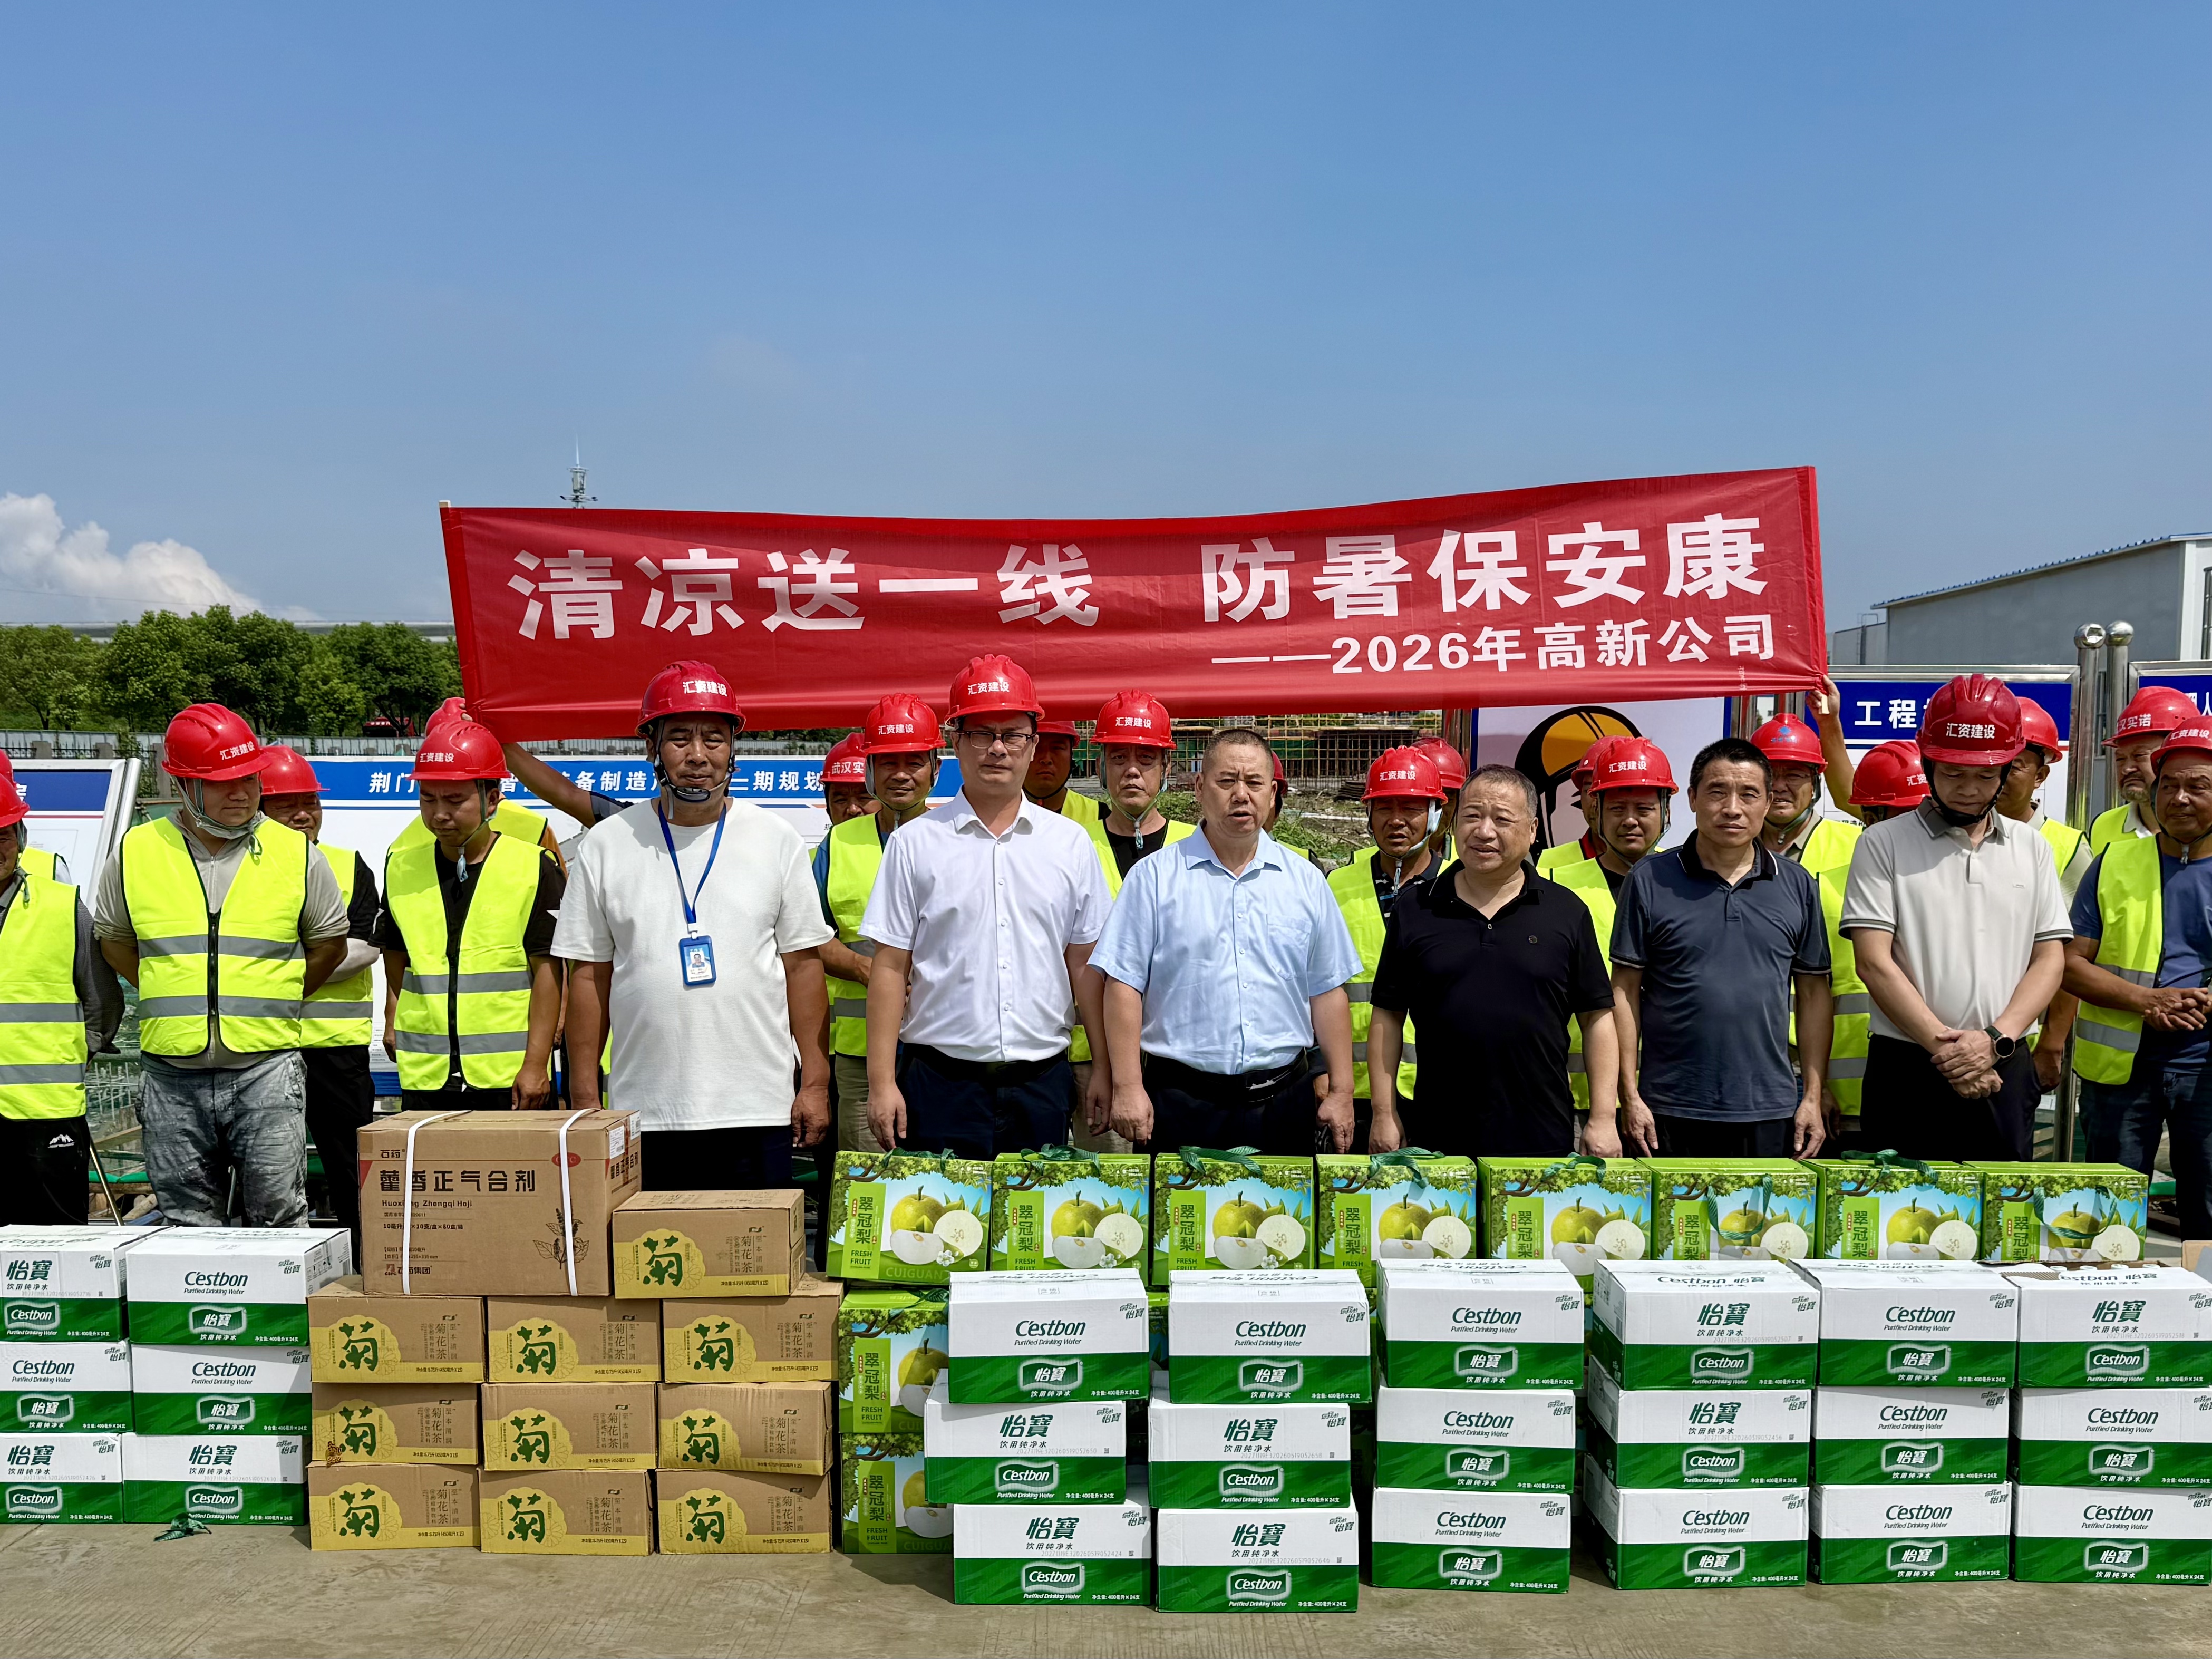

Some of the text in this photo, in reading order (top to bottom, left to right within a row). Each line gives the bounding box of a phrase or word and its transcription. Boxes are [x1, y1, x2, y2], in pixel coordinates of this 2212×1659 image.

[506, 512, 1768, 641] 清凉送一线 防暑保安康
[682, 680, 727, 697] 汇资建设
[967, 681, 1010, 696] 汇资建设
[1115, 716, 1152, 730] 汇资建设
[1854, 698, 1929, 729] 工程
[2117, 713, 2151, 732] 汉实诺
[878, 723, 914, 735] 汇资建设
[1946, 722, 1996, 739] 汇资建设
[2169, 729, 2210, 741] 汇资建设
[219, 741, 256, 761] 汇资建设
[420, 752, 454, 763] 汇资建设
[832, 762, 864, 774] 武汉实
[1379, 769, 1416, 781] 汇资建设
[1608, 759, 1647, 773] 汇资建设
[1906, 774, 1929, 786] 汇资
[382, 1200, 419, 1208] Huoxing
[856, 1197, 874, 1244] 翠冠梨
[1018, 1205, 1033, 1252] 翠冠梨
[1180, 1204, 1195, 1251] 翠冠梨
[1345, 1207, 1360, 1255] 翠冠梨
[1518, 1211, 1534, 1258] 翠冠梨
[1852, 1211, 1868, 1257] 翠冠梨
[642, 1235, 683, 1287] 菊
[741, 1236, 752, 1273] 菊花茶
[6, 1260, 52, 1280] 怡寶
[886, 1267, 943, 1280] CUIGUAN
[203, 1314, 231, 1326] 怡寶
[1697, 1303, 1750, 1325] 怡寶
[2092, 1301, 2146, 1322] 怡寶
[339, 1321, 378, 1371] 菊
[435, 1323, 447, 1360] 菊花茶
[516, 1325, 556, 1376] 菊
[615, 1323, 625, 1360] 菊花茶
[693, 1322, 734, 1371] 菊
[792, 1322, 803, 1358] 菊花茶
[1470, 1355, 1501, 1367] 怡寶
[1903, 1353, 1934, 1366] 怡寶
[865, 1352, 880, 1400] 翠冠梨
[1035, 1367, 1066, 1381] 怡寶
[1255, 1369, 1286, 1382] 怡寶
[32, 1402, 59, 1414] 怡寶
[211, 1404, 239, 1416] 怡寶
[1689, 1402, 1741, 1424] 怡寶
[339, 1406, 376, 1457] 菊
[431, 1408, 442, 1443] 菊花茶
[608, 1413, 618, 1449] 菊花茶
[776, 1418, 786, 1454] 菊花茶
[1000, 1414, 1053, 1437] 怡寶
[1224, 1419, 1278, 1441] 怡寶
[510, 1414, 550, 1463] 菊
[682, 1416, 719, 1464] 菊
[7, 1445, 54, 1465] 怡寶
[189, 1445, 237, 1465] 怡寶
[1462, 1458, 1493, 1471] 怡寶
[1897, 1451, 1927, 1463] 怡寶
[2105, 1454, 2137, 1467] 怡寶
[436, 1489, 448, 1525] 菊花茶
[869, 1475, 885, 1522] 翠冠梨
[339, 1488, 379, 1538] 菊
[507, 1493, 545, 1543] 菊
[600, 1498, 612, 1533] 菊花茶
[686, 1495, 725, 1544] 菊
[782, 1496, 793, 1531] 菊花茶
[1026, 1517, 1079, 1539] 怡寶
[1231, 1524, 1285, 1546] 怡寶
[904, 1542, 953, 1551] CUIGUA
[1902, 1549, 1932, 1562] 怡寶
[2100, 1550, 2132, 1563] 怡寶
[1454, 1557, 1486, 1570] 怡寶
[1699, 1555, 1729, 1567] 怡寶
